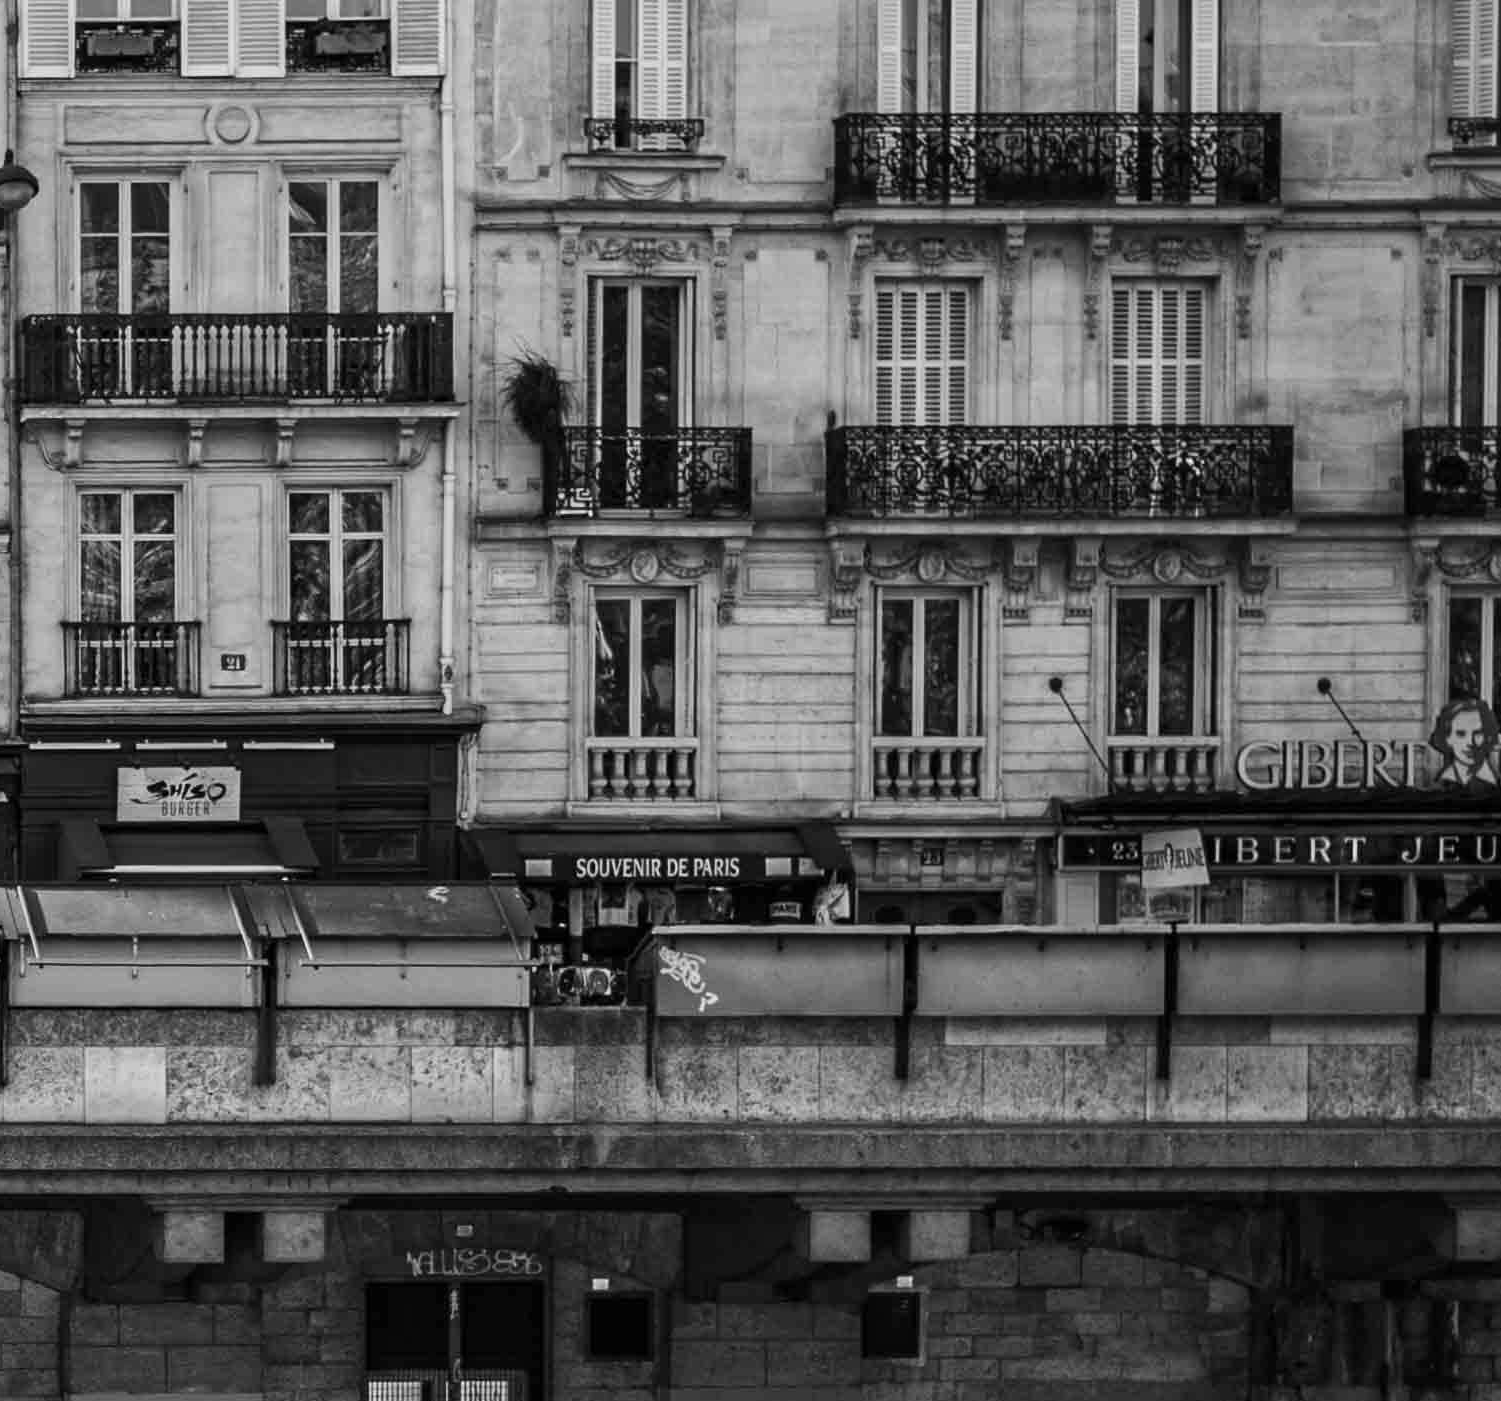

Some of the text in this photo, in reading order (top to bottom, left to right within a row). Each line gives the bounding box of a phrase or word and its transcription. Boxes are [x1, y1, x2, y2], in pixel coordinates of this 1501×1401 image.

[226, 656, 240, 670] 21
[1236, 739, 1431, 790] GIBERT
[161, 801, 211, 817] BURGER
[1112, 841, 1138, 860] 23
[1213, 836, 1367, 864] IBERT
[575, 857, 740, 879] SOUVENIR DE PARIS
